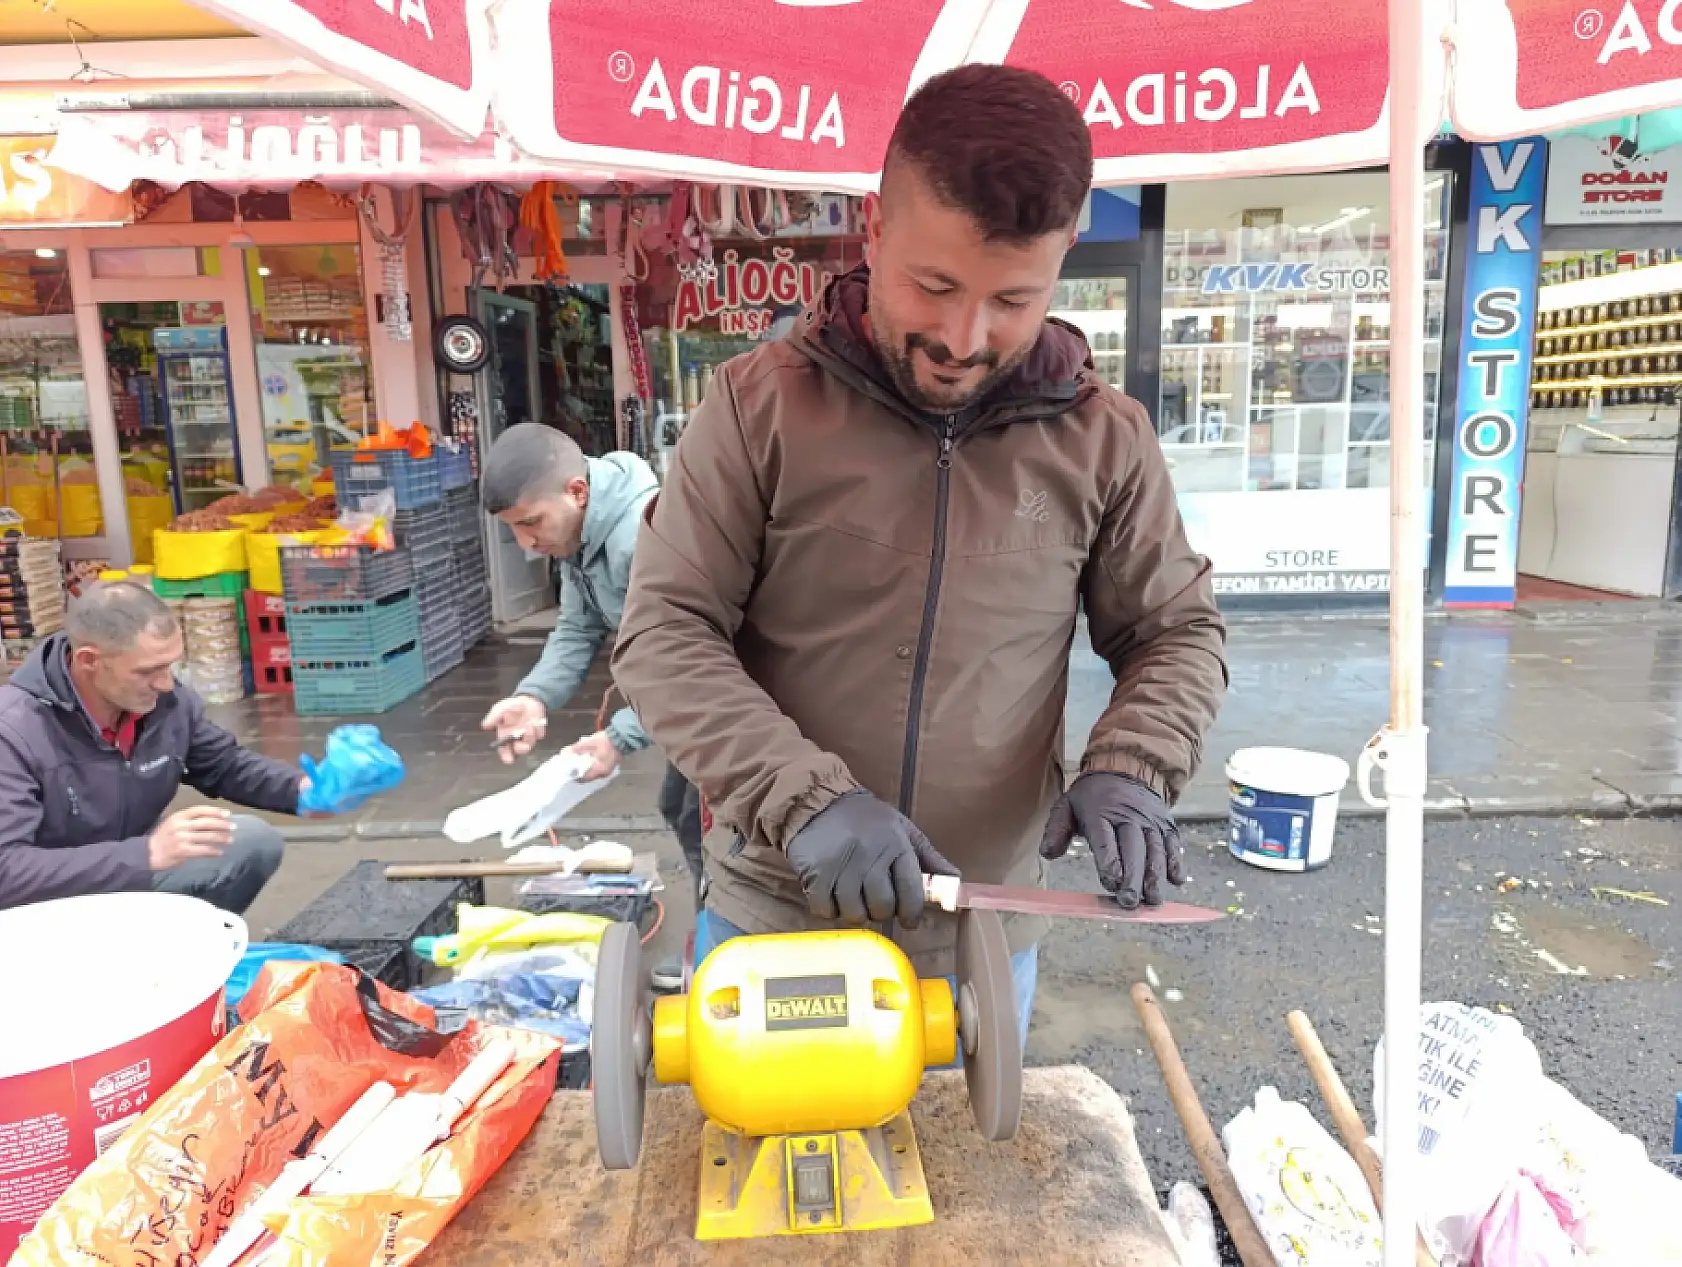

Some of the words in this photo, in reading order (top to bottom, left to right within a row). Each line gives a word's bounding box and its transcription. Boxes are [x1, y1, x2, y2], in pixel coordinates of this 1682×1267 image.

[1477, 142, 1534, 252] VK
[1201, 263, 1314, 294] KVK
[1317, 268, 1390, 291] STOR
[1462, 289, 1520, 572] STORE
[1265, 550, 1339, 567] STORE
[1212, 576, 1260, 592] EFON
